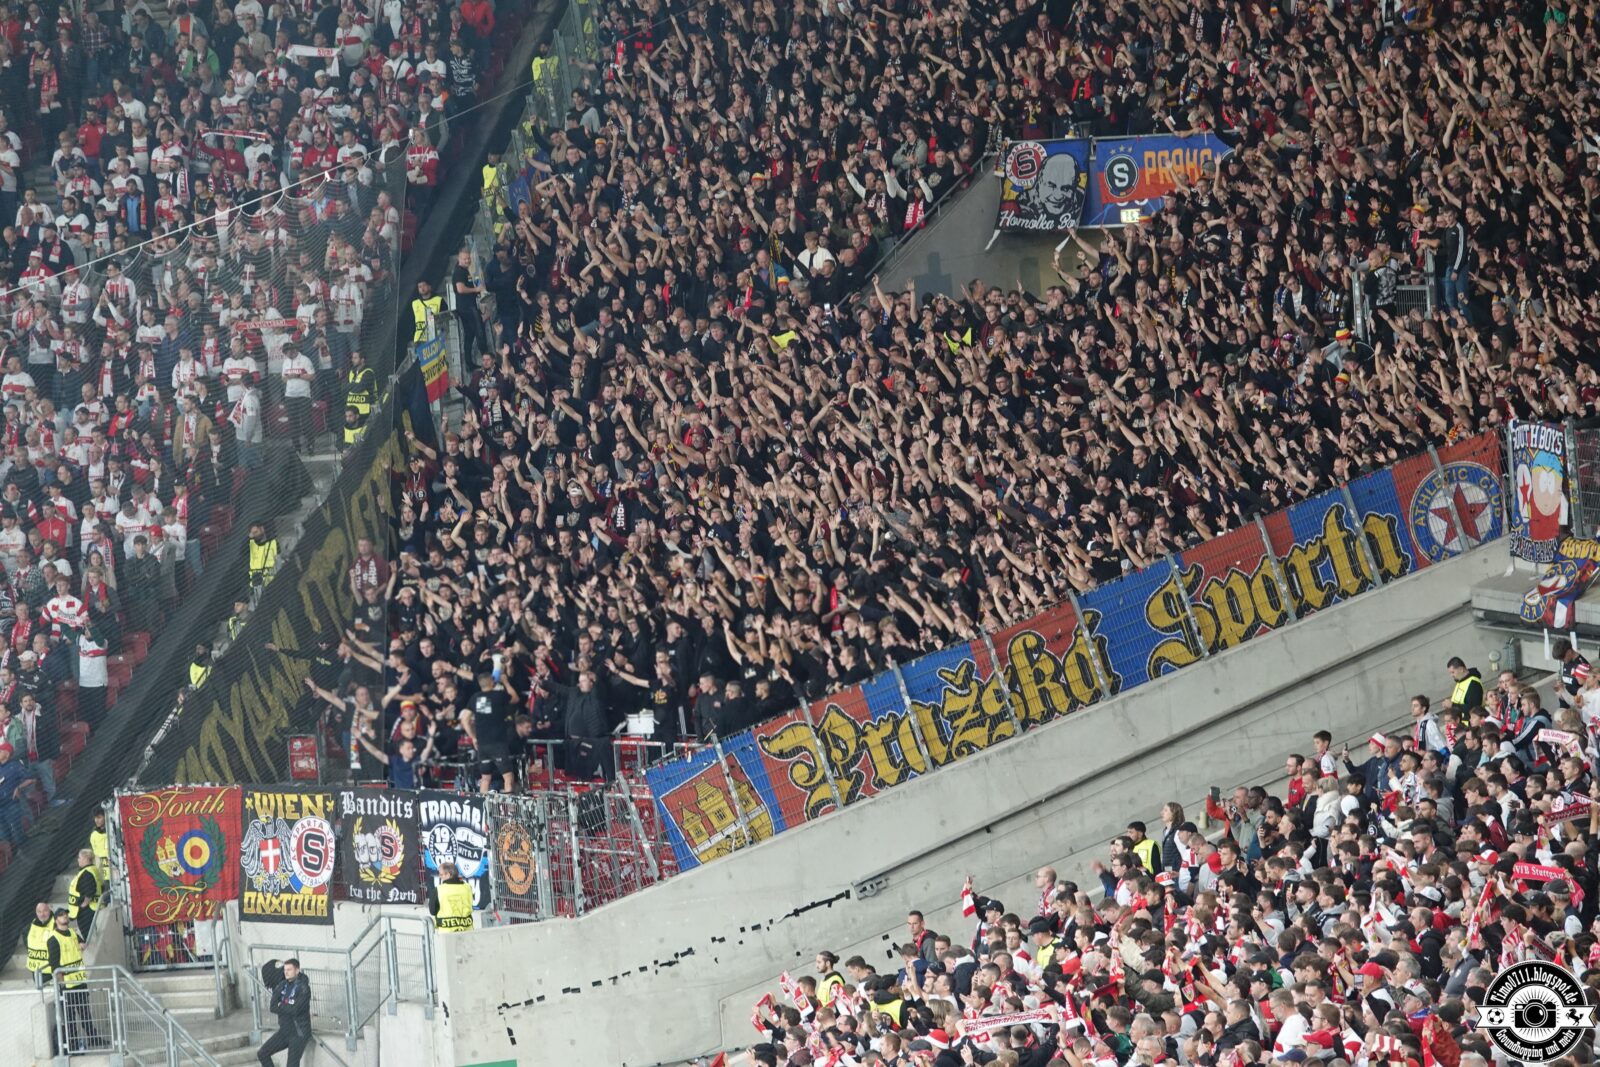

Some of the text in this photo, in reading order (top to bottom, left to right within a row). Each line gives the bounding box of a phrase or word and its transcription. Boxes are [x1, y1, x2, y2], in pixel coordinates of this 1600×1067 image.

[998, 210, 1077, 230] Homolka Bo
[1540, 426, 1564, 455] BOYS
[1415, 467, 1502, 528] ATHLETIC CLUB
[1145, 503, 1412, 682] Sparta
[128, 785, 240, 828] Youth
[253, 792, 325, 820] WIEN
[340, 791, 414, 819] Bandits
[434, 827, 450, 843] 19
[366, 885, 381, 902] the
